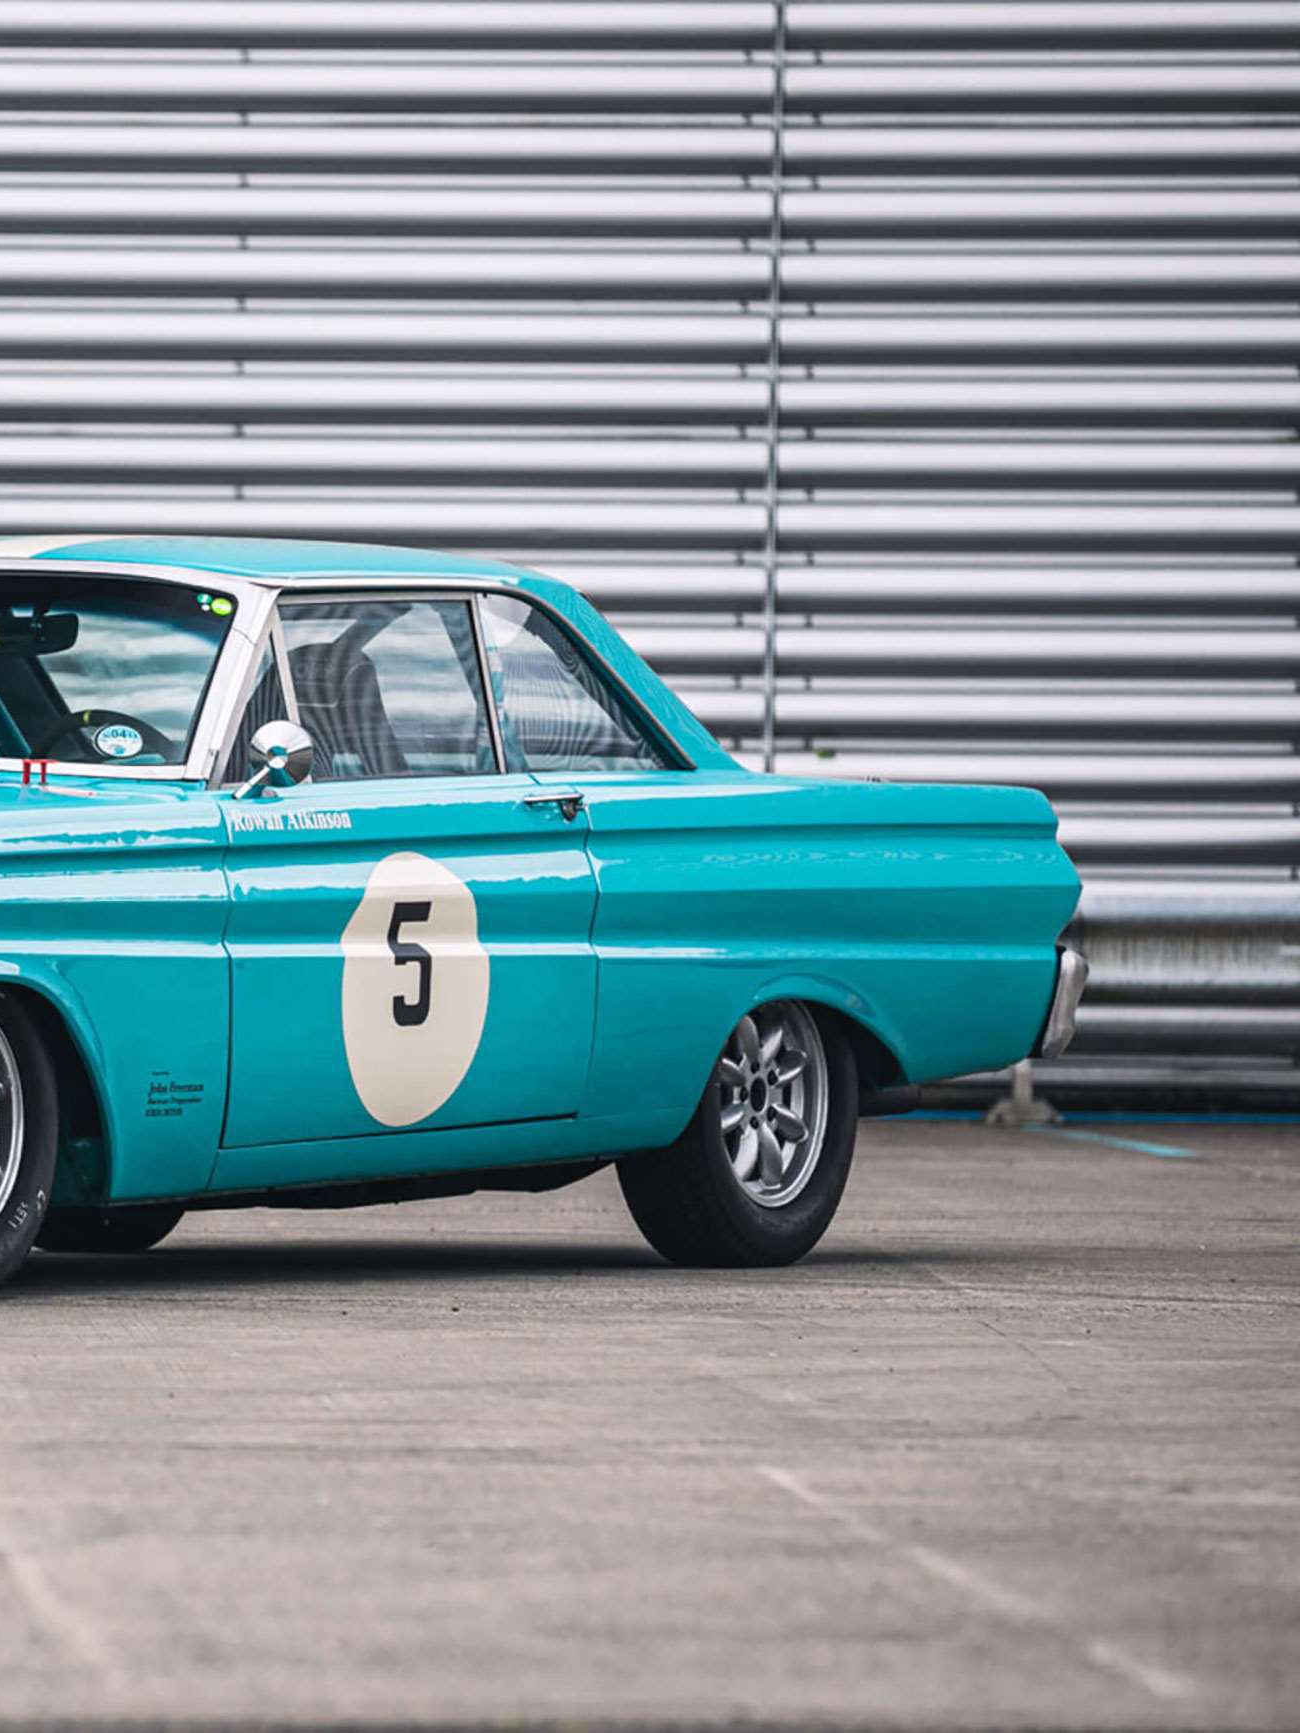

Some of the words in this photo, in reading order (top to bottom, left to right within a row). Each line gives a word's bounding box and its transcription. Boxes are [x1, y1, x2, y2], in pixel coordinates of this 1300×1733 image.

[232, 812, 284, 832] Rowan
[287, 809, 352, 830] Atkinson
[387, 901, 432, 1028] 5
